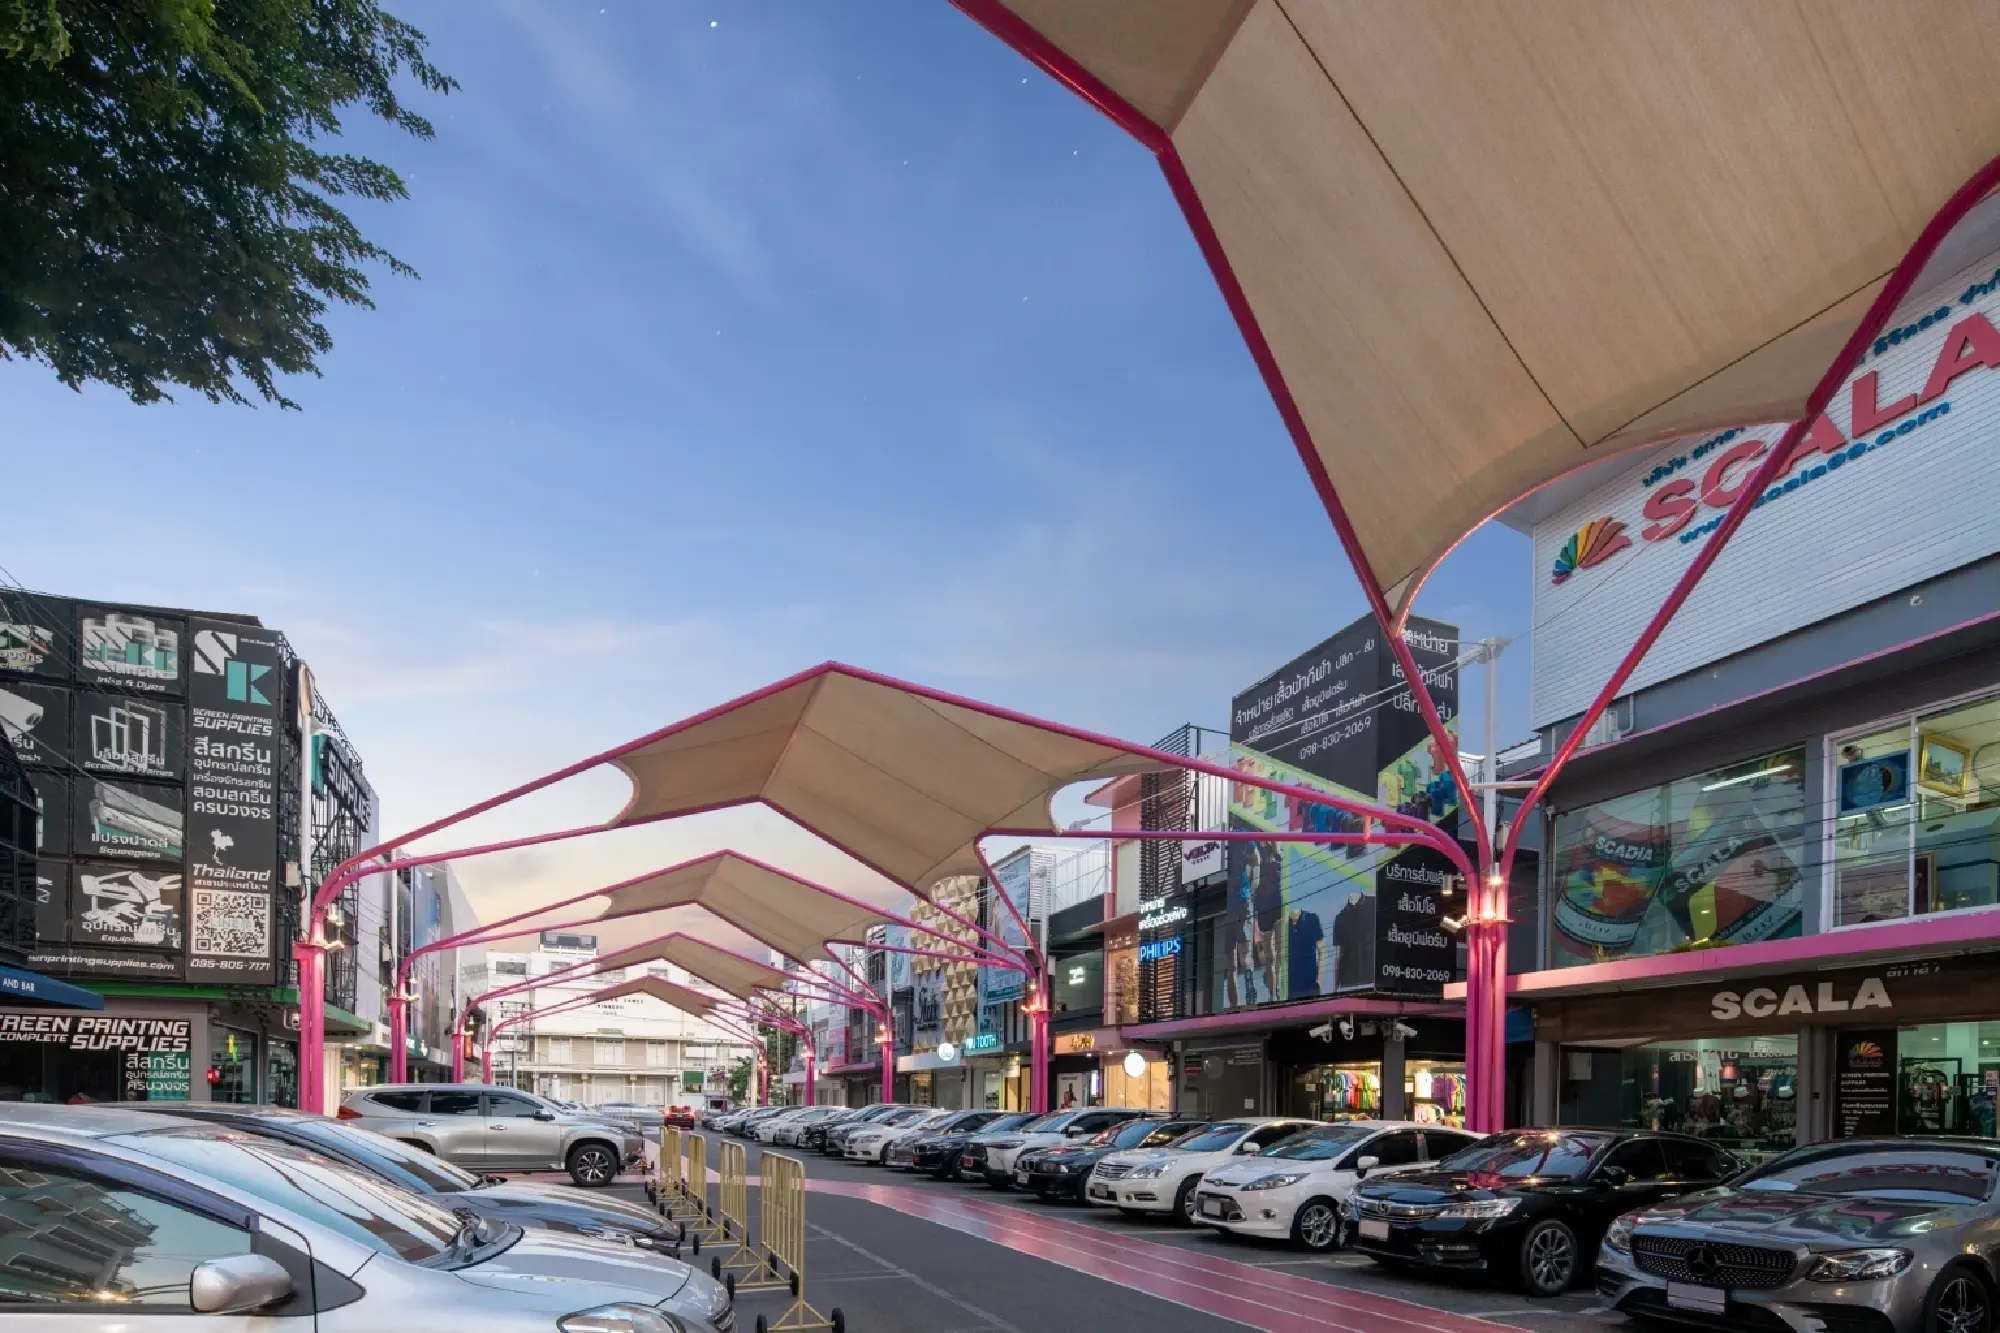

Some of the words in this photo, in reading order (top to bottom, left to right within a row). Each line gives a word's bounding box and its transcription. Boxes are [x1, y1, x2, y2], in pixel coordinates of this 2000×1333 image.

[1643, 312, 2000, 541] SCALA
[193, 716, 273, 736] SUPPLIES
[1300, 716, 1371, 760] 098-830-2069
[193, 736, 271, 763] สีสกรีน
[193, 758, 271, 776] อุปกรณ์สกรีน
[193, 786, 271, 804] สอนสกรีน
[193, 801, 271, 819] ครบวงจร
[192, 863, 271, 881] Thailand
[1140, 938, 1181, 961] PHILIPS
[21, 981, 35, 992] BAR
[1711, 977, 1893, 1019] SCALA
[0, 1015, 71, 1032] REEN
[77, 1017, 190, 1036] PRINTING
[70, 1034, 190, 1052] SUPPLIES
[126, 1052, 190, 1070] สีสกรีน
